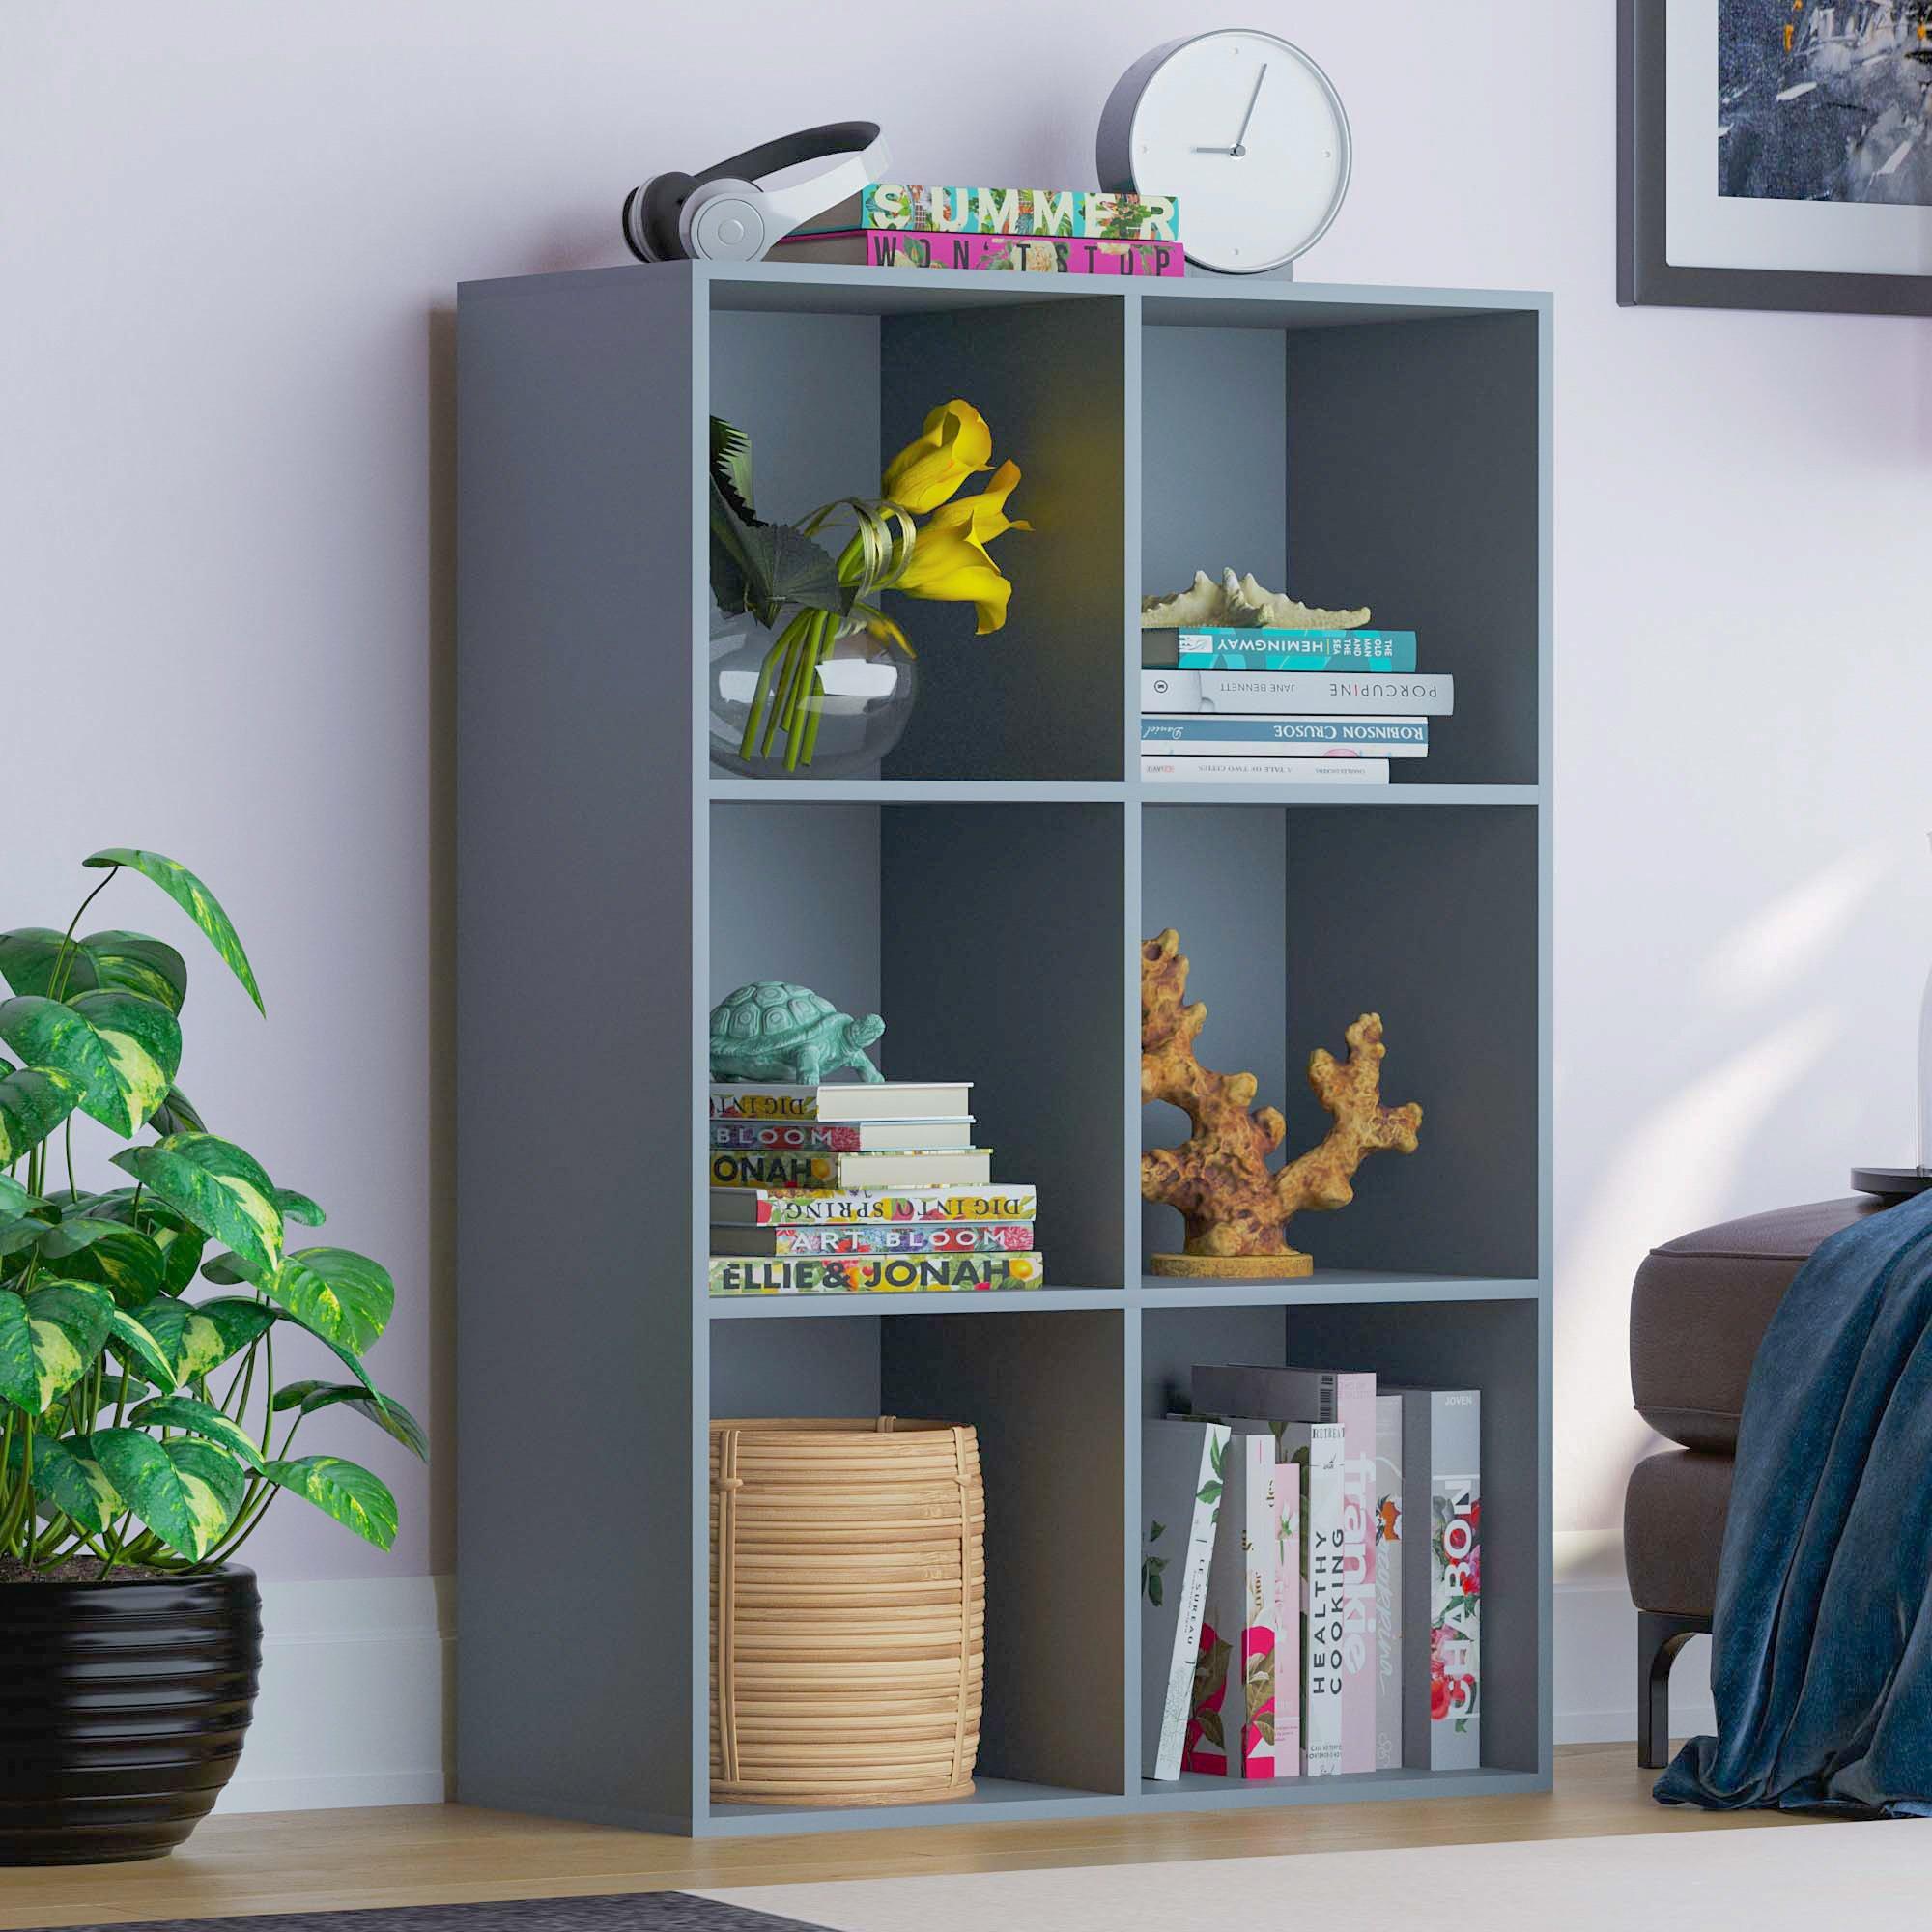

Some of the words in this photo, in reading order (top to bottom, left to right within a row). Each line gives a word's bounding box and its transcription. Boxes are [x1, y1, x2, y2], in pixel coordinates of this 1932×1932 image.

[873, 184, 1176, 242] SUMMER
[1218, 639, 1323, 653] HEMINGWAY
[1220, 682, 1266, 693] BENNETT
[1270, 683, 1295, 693] JANE
[1329, 683, 1437, 697] PORCUPINE
[1144, 725, 1184, 740] Daniel
[1274, 724, 1337, 739] CRUSOE
[1343, 725, 1424, 741] ROBINSON
[710, 1096, 754, 1115] INT
[764, 1097, 805, 1114] DIG
[717, 1126, 833, 1145] BLOOM
[786, 1201, 884, 1219] SPRING
[897, 1199, 971, 1216] INTO
[976, 1198, 1020, 1215] DIG
[791, 1231, 863, 1251] ART
[886, 1229, 1007, 1247] BLOOM
[864, 1259, 1010, 1289] JONAH
[1444, 1396, 1472, 1406] JOVEN
[1343, 1453, 1376, 1674] frankie
[1444, 1479, 1473, 1715] CHARBON
[1186, 1583, 1203, 1645] SUREAU
[1313, 1531, 1327, 1694] HEALTHY
[1331, 1528, 1344, 1695] COOKING
